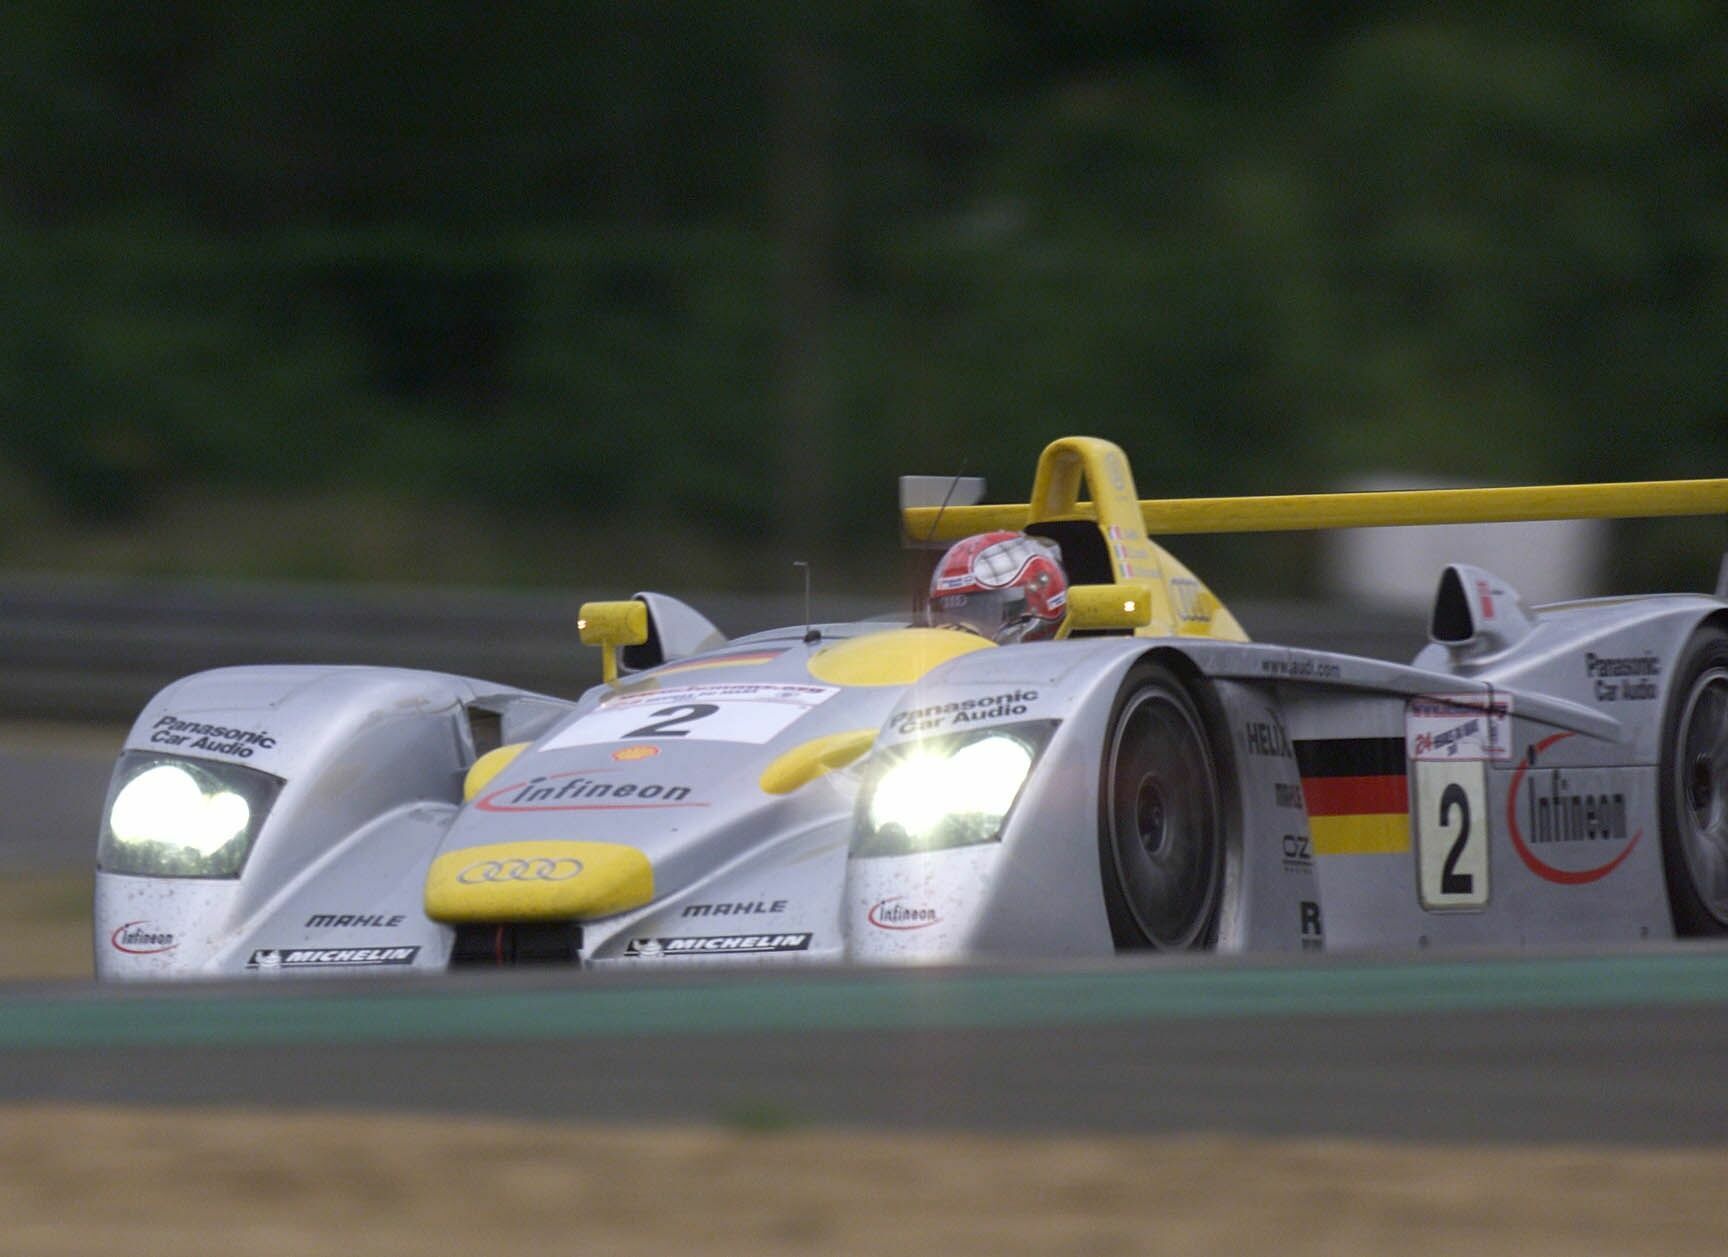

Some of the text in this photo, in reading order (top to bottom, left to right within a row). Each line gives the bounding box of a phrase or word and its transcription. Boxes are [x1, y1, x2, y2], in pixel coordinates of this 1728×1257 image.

[620, 703, 720, 739] 2
[889, 690, 1039, 728] Panasonic
[898, 703, 1028, 735] Car Audio
[151, 730, 254, 759] Car Audio
[152, 715, 277, 750] Panasonic
[1439, 783, 1474, 894] 2
[305, 914, 407, 929] MAHLE
[682, 900, 789, 918] MAHLE
[285, 948, 415, 963] MICHELIN
[667, 934, 804, 951] MICHELIN
